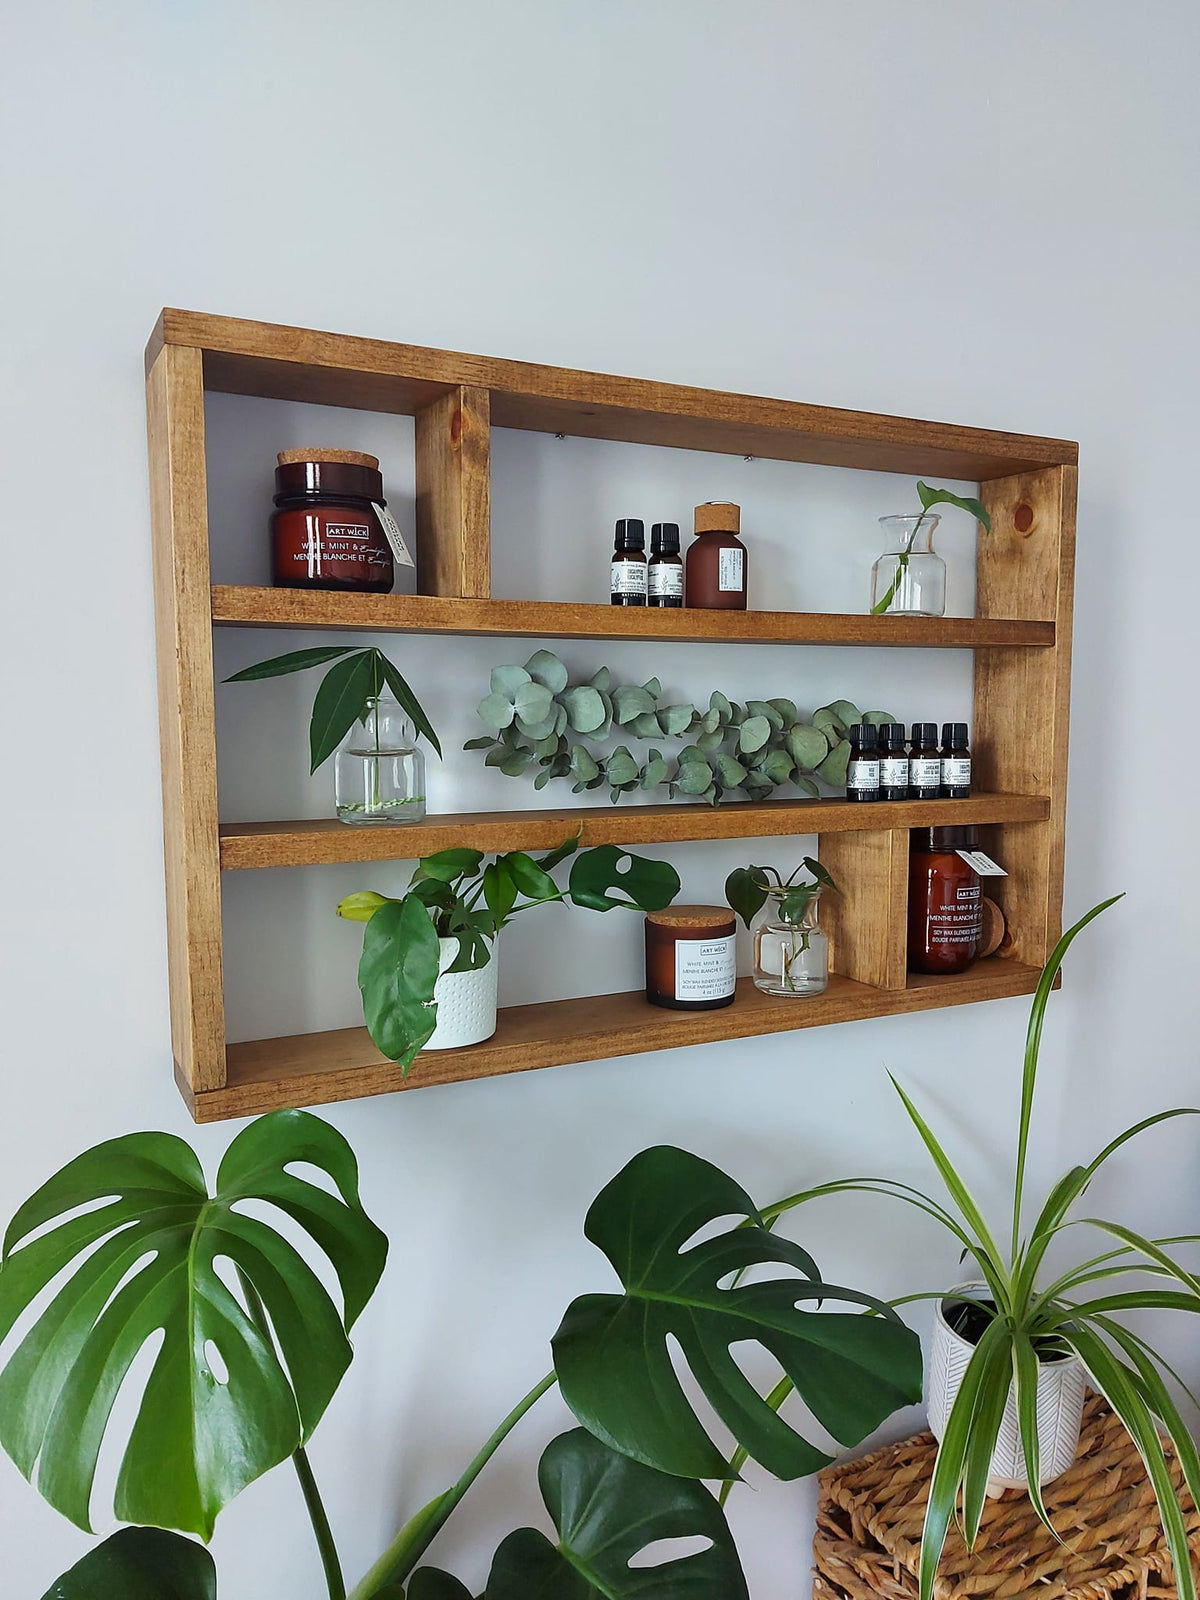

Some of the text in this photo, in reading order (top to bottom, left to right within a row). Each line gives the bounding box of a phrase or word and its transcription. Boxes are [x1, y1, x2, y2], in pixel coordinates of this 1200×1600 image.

[347, 526, 367, 537] WICK
[329, 542, 349, 550] MINT
[323, 553, 357, 561] BLANCHE
